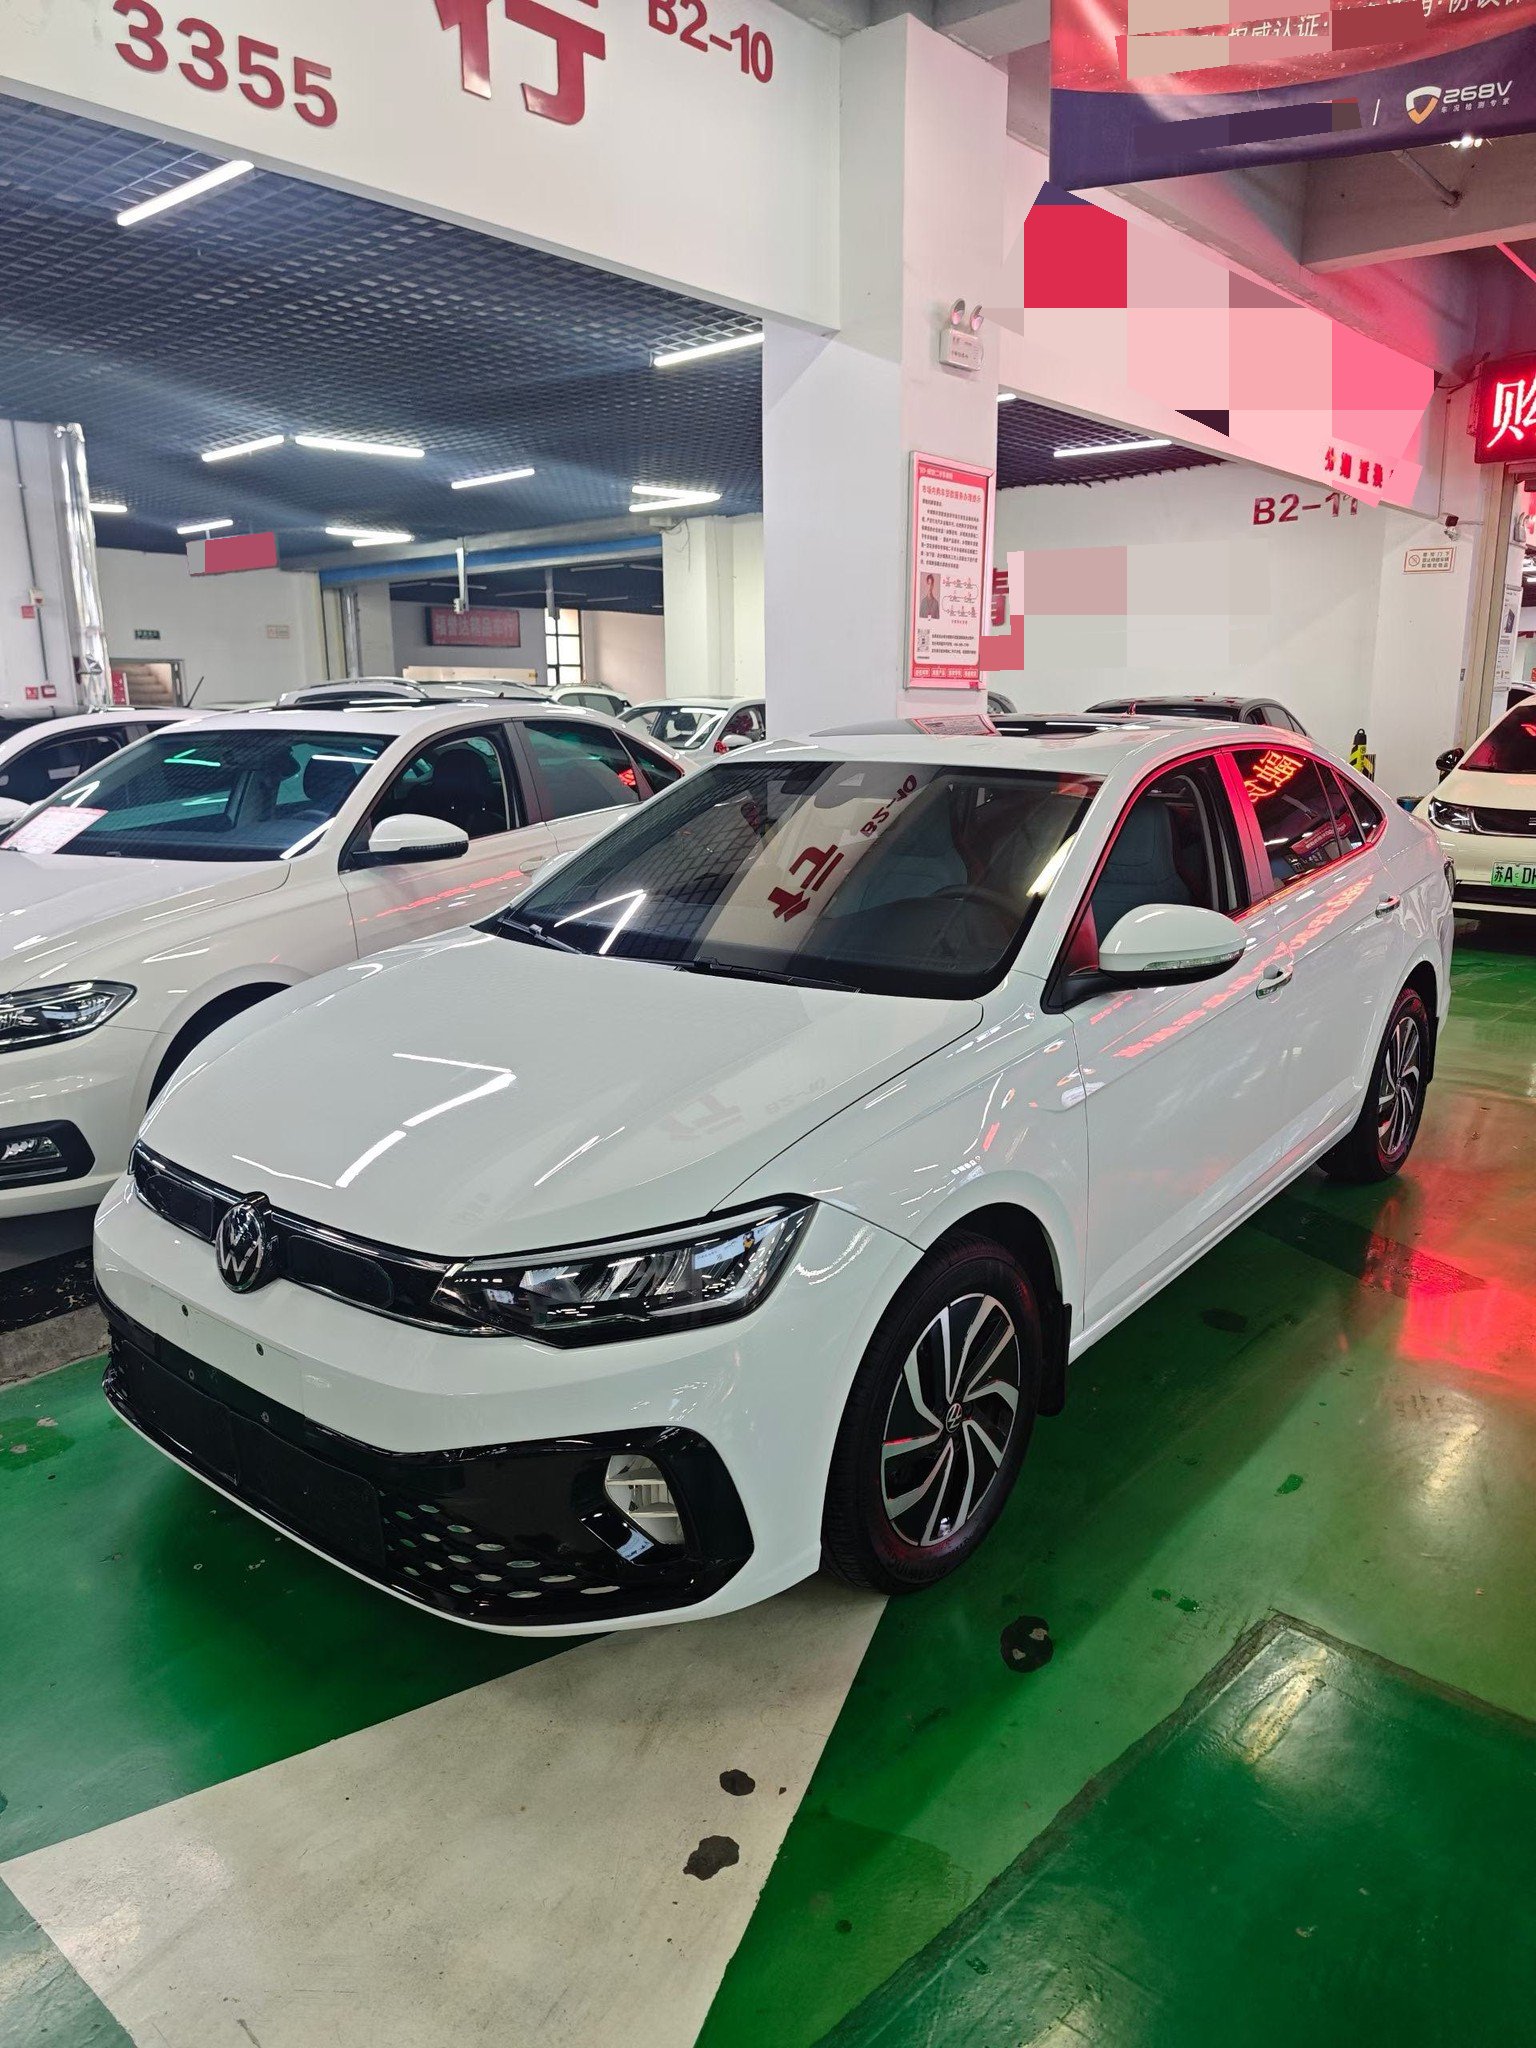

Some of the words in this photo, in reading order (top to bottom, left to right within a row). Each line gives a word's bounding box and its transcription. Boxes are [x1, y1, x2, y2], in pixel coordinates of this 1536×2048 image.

[112, 0, 338, 127] 3355
[649, 0, 774, 83] B2-10
[1443, 80, 1513, 104] 268V
